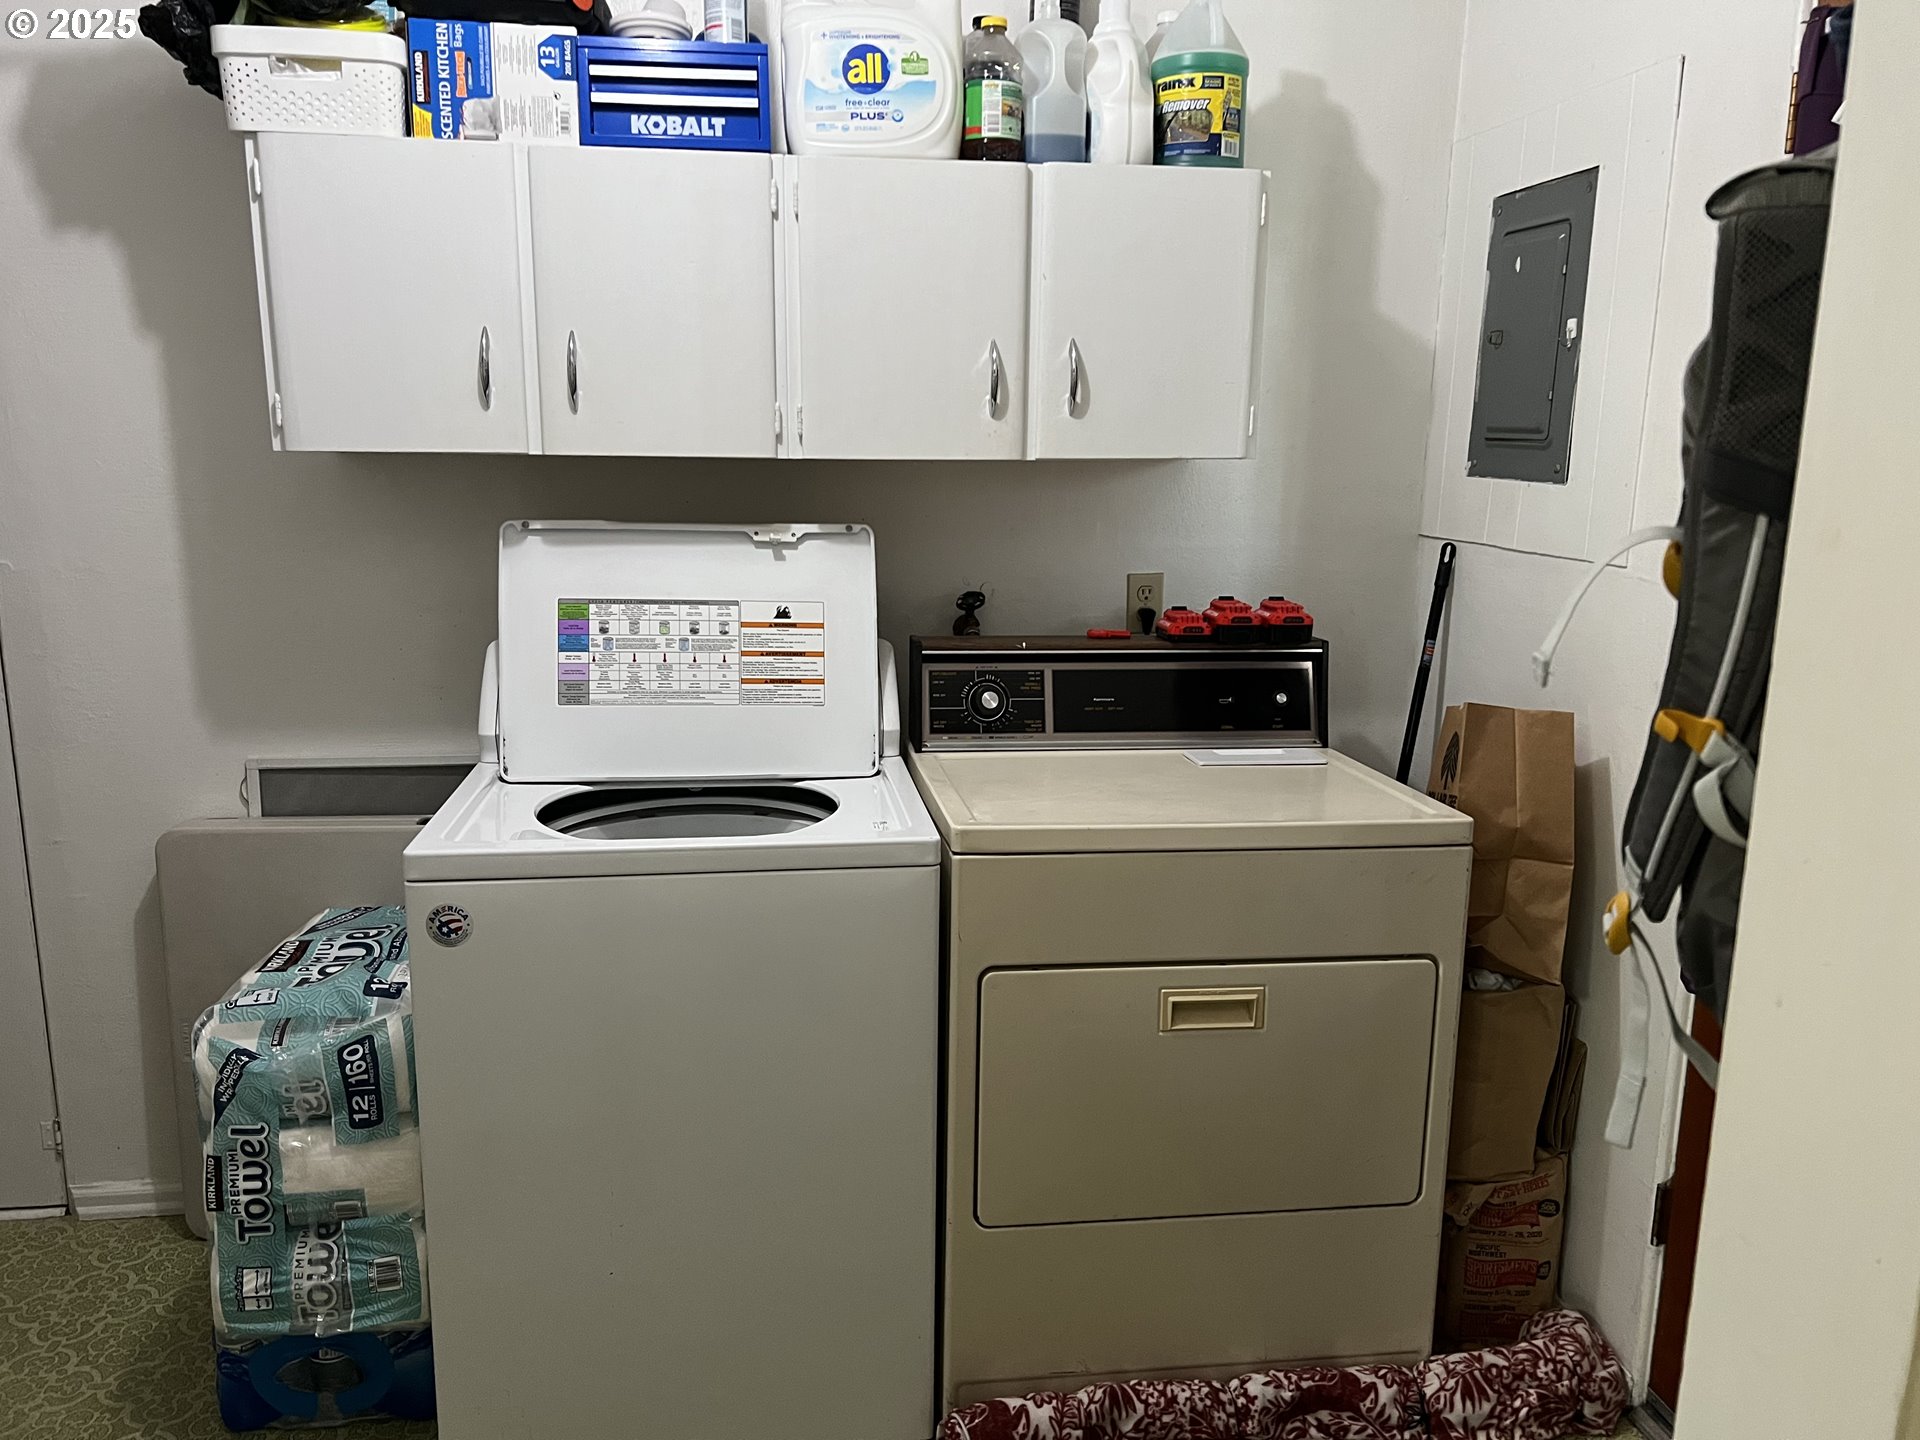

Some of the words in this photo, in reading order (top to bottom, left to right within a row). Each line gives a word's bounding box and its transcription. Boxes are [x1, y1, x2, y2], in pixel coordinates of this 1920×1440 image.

[454, 23, 465, 48] Bags
[435, 23, 450, 79] KITCHEN
[540, 46, 555, 67] 13
[563, 39, 572, 61] BAGS
[414, 52, 425, 102] KIRKLAND
[564, 61, 572, 77] 200
[847, 52, 883, 84] all
[438, 83, 454, 139] SCENTED
[845, 98, 863, 107] free
[867, 98, 891, 107] clear
[1162, 98, 1211, 114] Remover
[630, 114, 726, 137] KOBALT
[850, 112, 885, 121] PLUS
[428, 905, 469, 924] AMERICA
[363, 1039, 371, 1054] ROLL
[342, 1044, 369, 1084] 160
[352, 1095, 370, 1123] 12
[369, 1094, 378, 1121] ROLLS
[206, 1157, 218, 1210] KIRKLAND
[227, 1151, 242, 1215] PREMIUM
[229, 1122, 274, 1243] Towel
[297, 1221, 341, 1323] Towe
[1466, 1260, 1537, 1275] SPORTSMEN'S
[1466, 1274, 1498, 1287] SHOW
